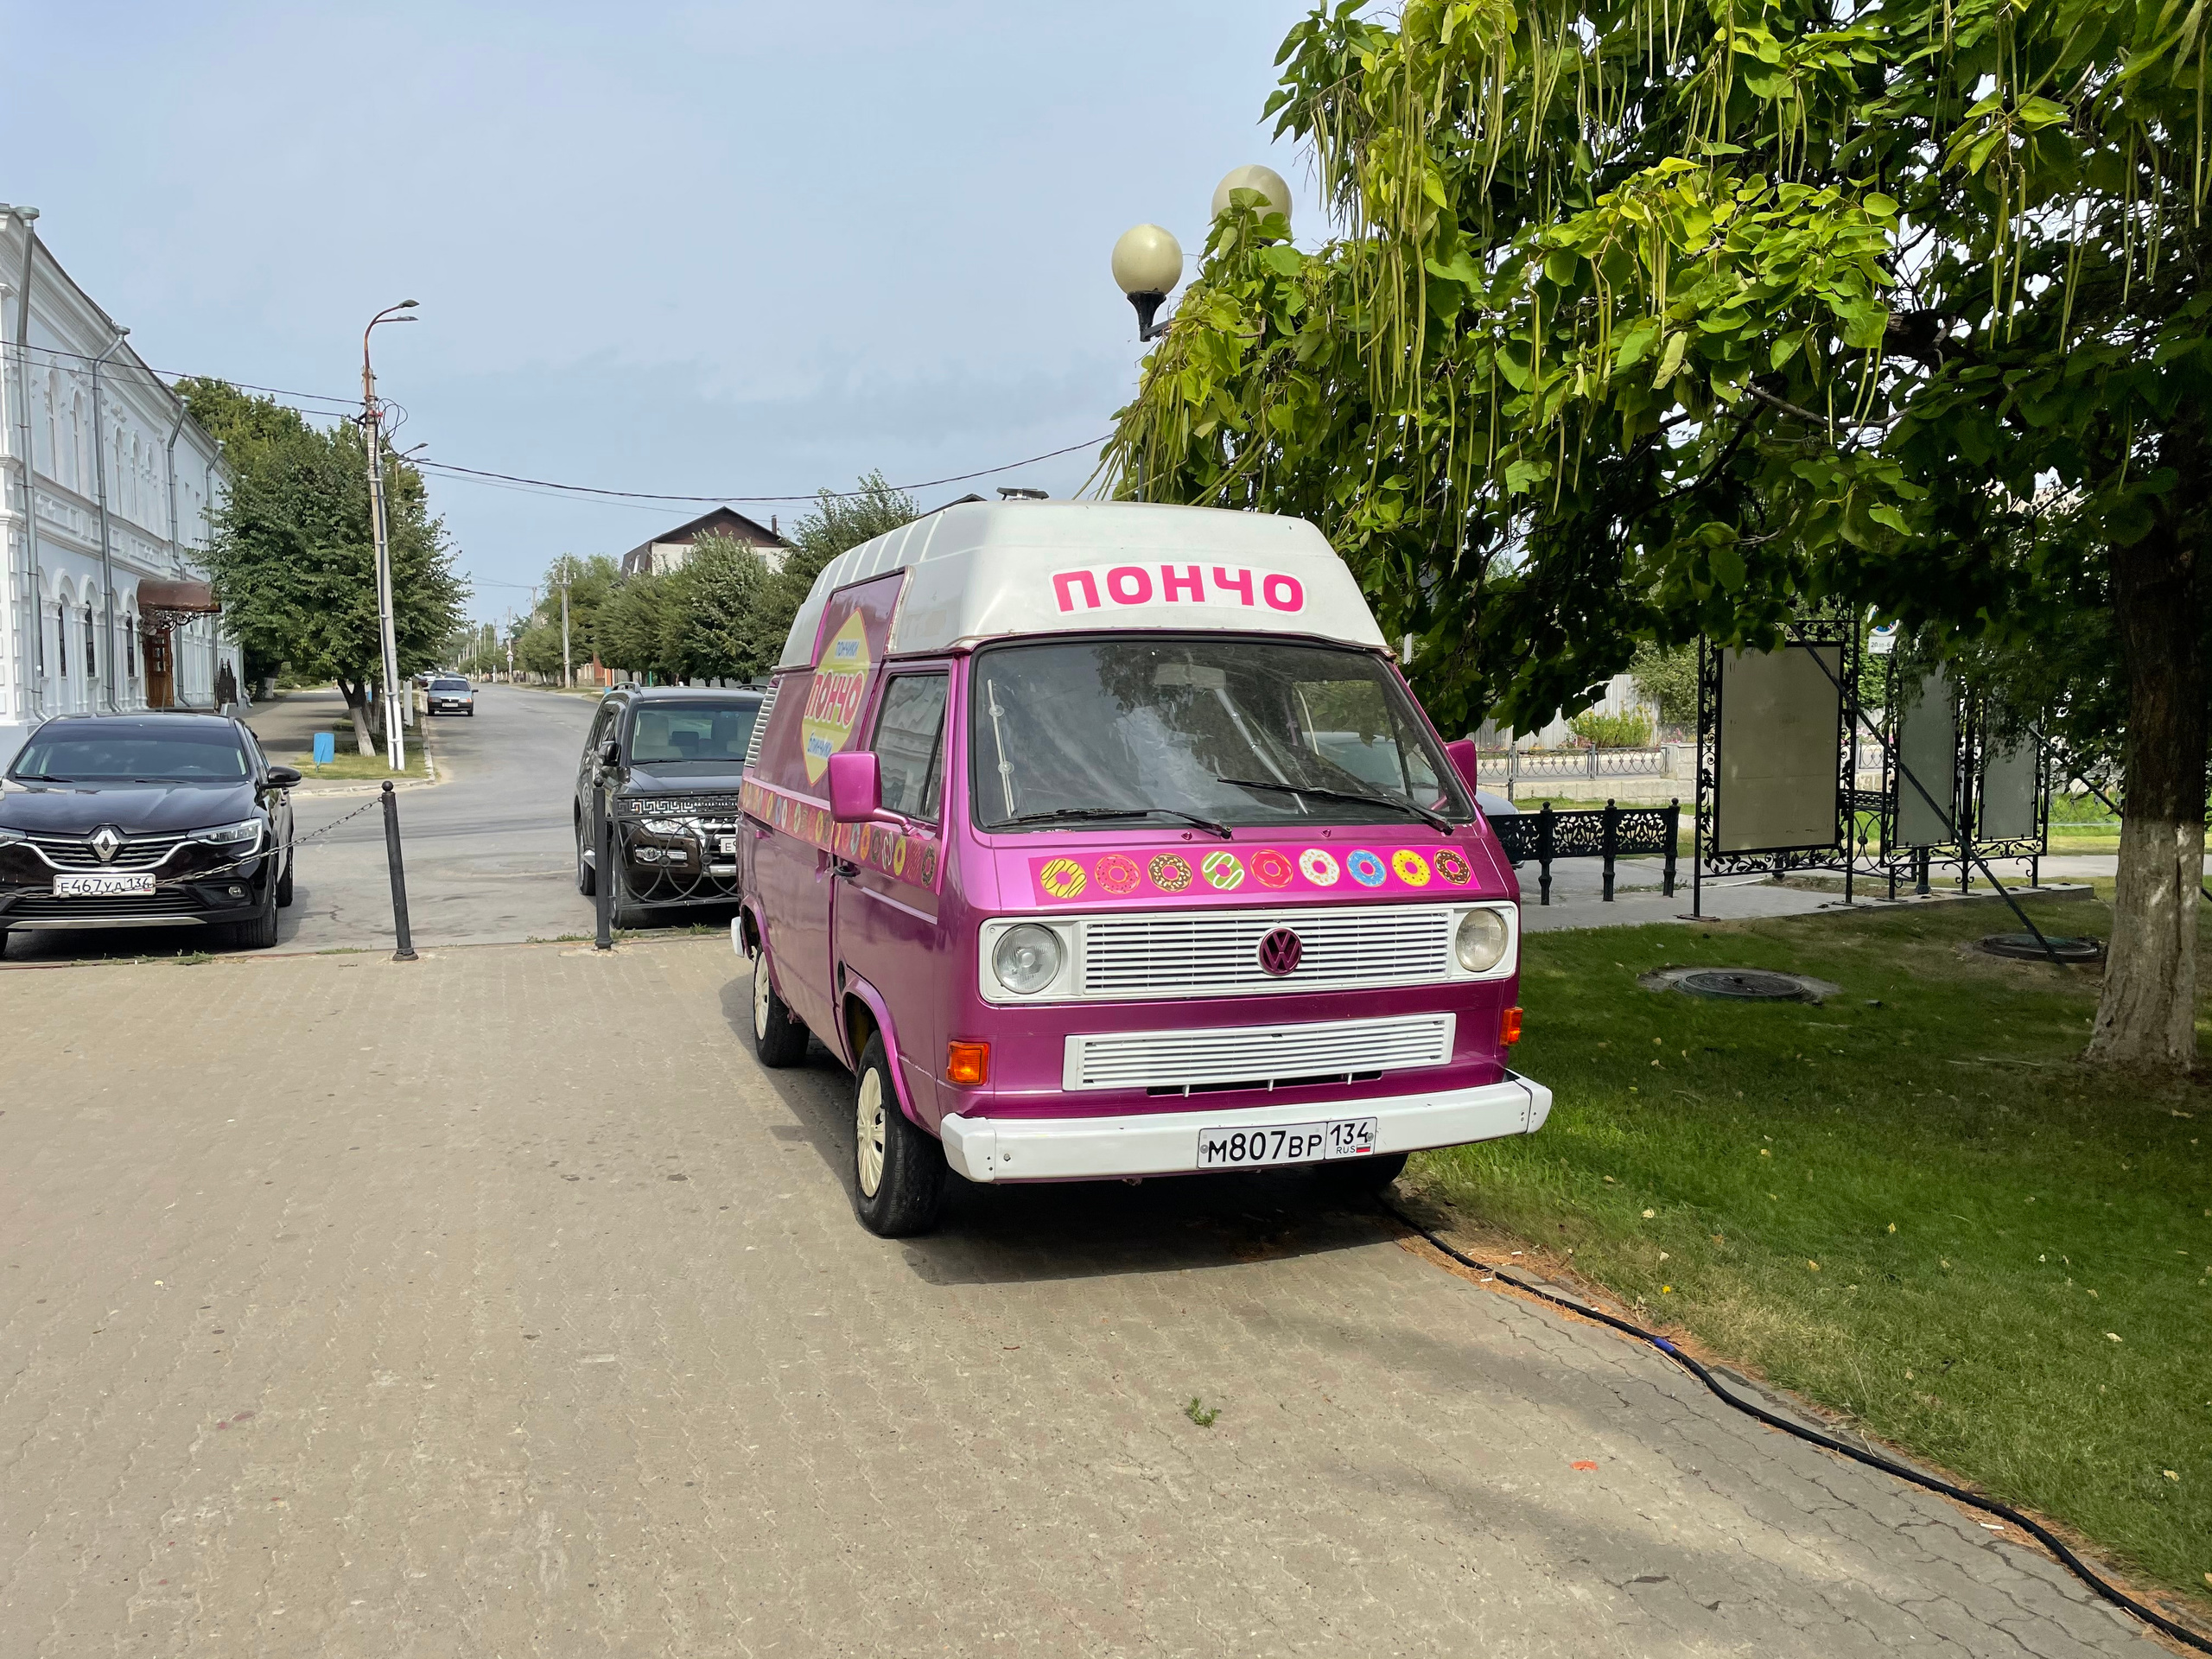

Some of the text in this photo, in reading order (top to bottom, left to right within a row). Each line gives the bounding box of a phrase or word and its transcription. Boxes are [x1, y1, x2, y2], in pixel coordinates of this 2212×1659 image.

[1052, 564, 1304, 613] ПОНЧО
[804, 671, 863, 727] ПОНЧО
[1207, 1122, 1370, 1163] М807ВР 134
[1336, 1145, 1356, 1154] RUS
